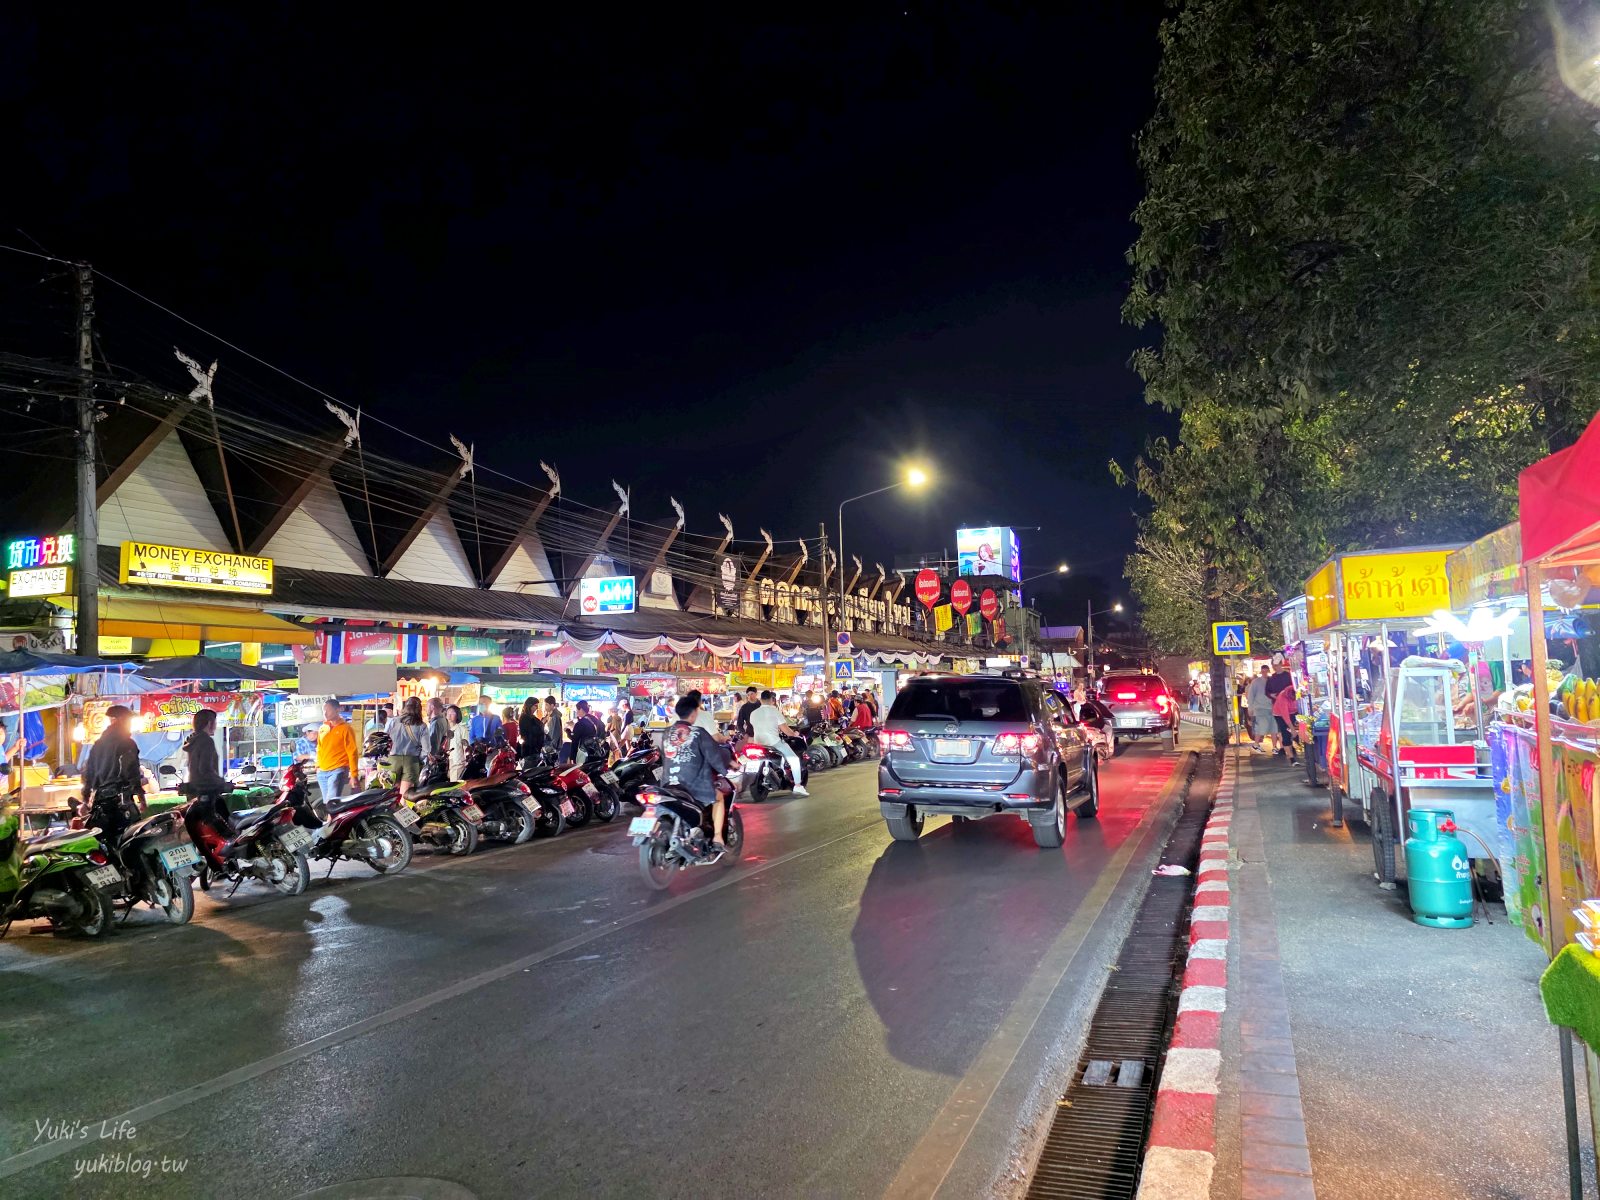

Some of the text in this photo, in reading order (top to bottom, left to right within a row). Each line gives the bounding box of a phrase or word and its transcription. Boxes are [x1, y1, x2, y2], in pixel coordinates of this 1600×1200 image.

[8, 534, 74, 569] 货币兑换
[134, 544, 269, 570] MONEY EXCHANGE
[12, 569, 65, 585] EXCHANGE
[234, 580, 267, 588] COMMISSION
[1347, 566, 1406, 611] เต้าหู้
